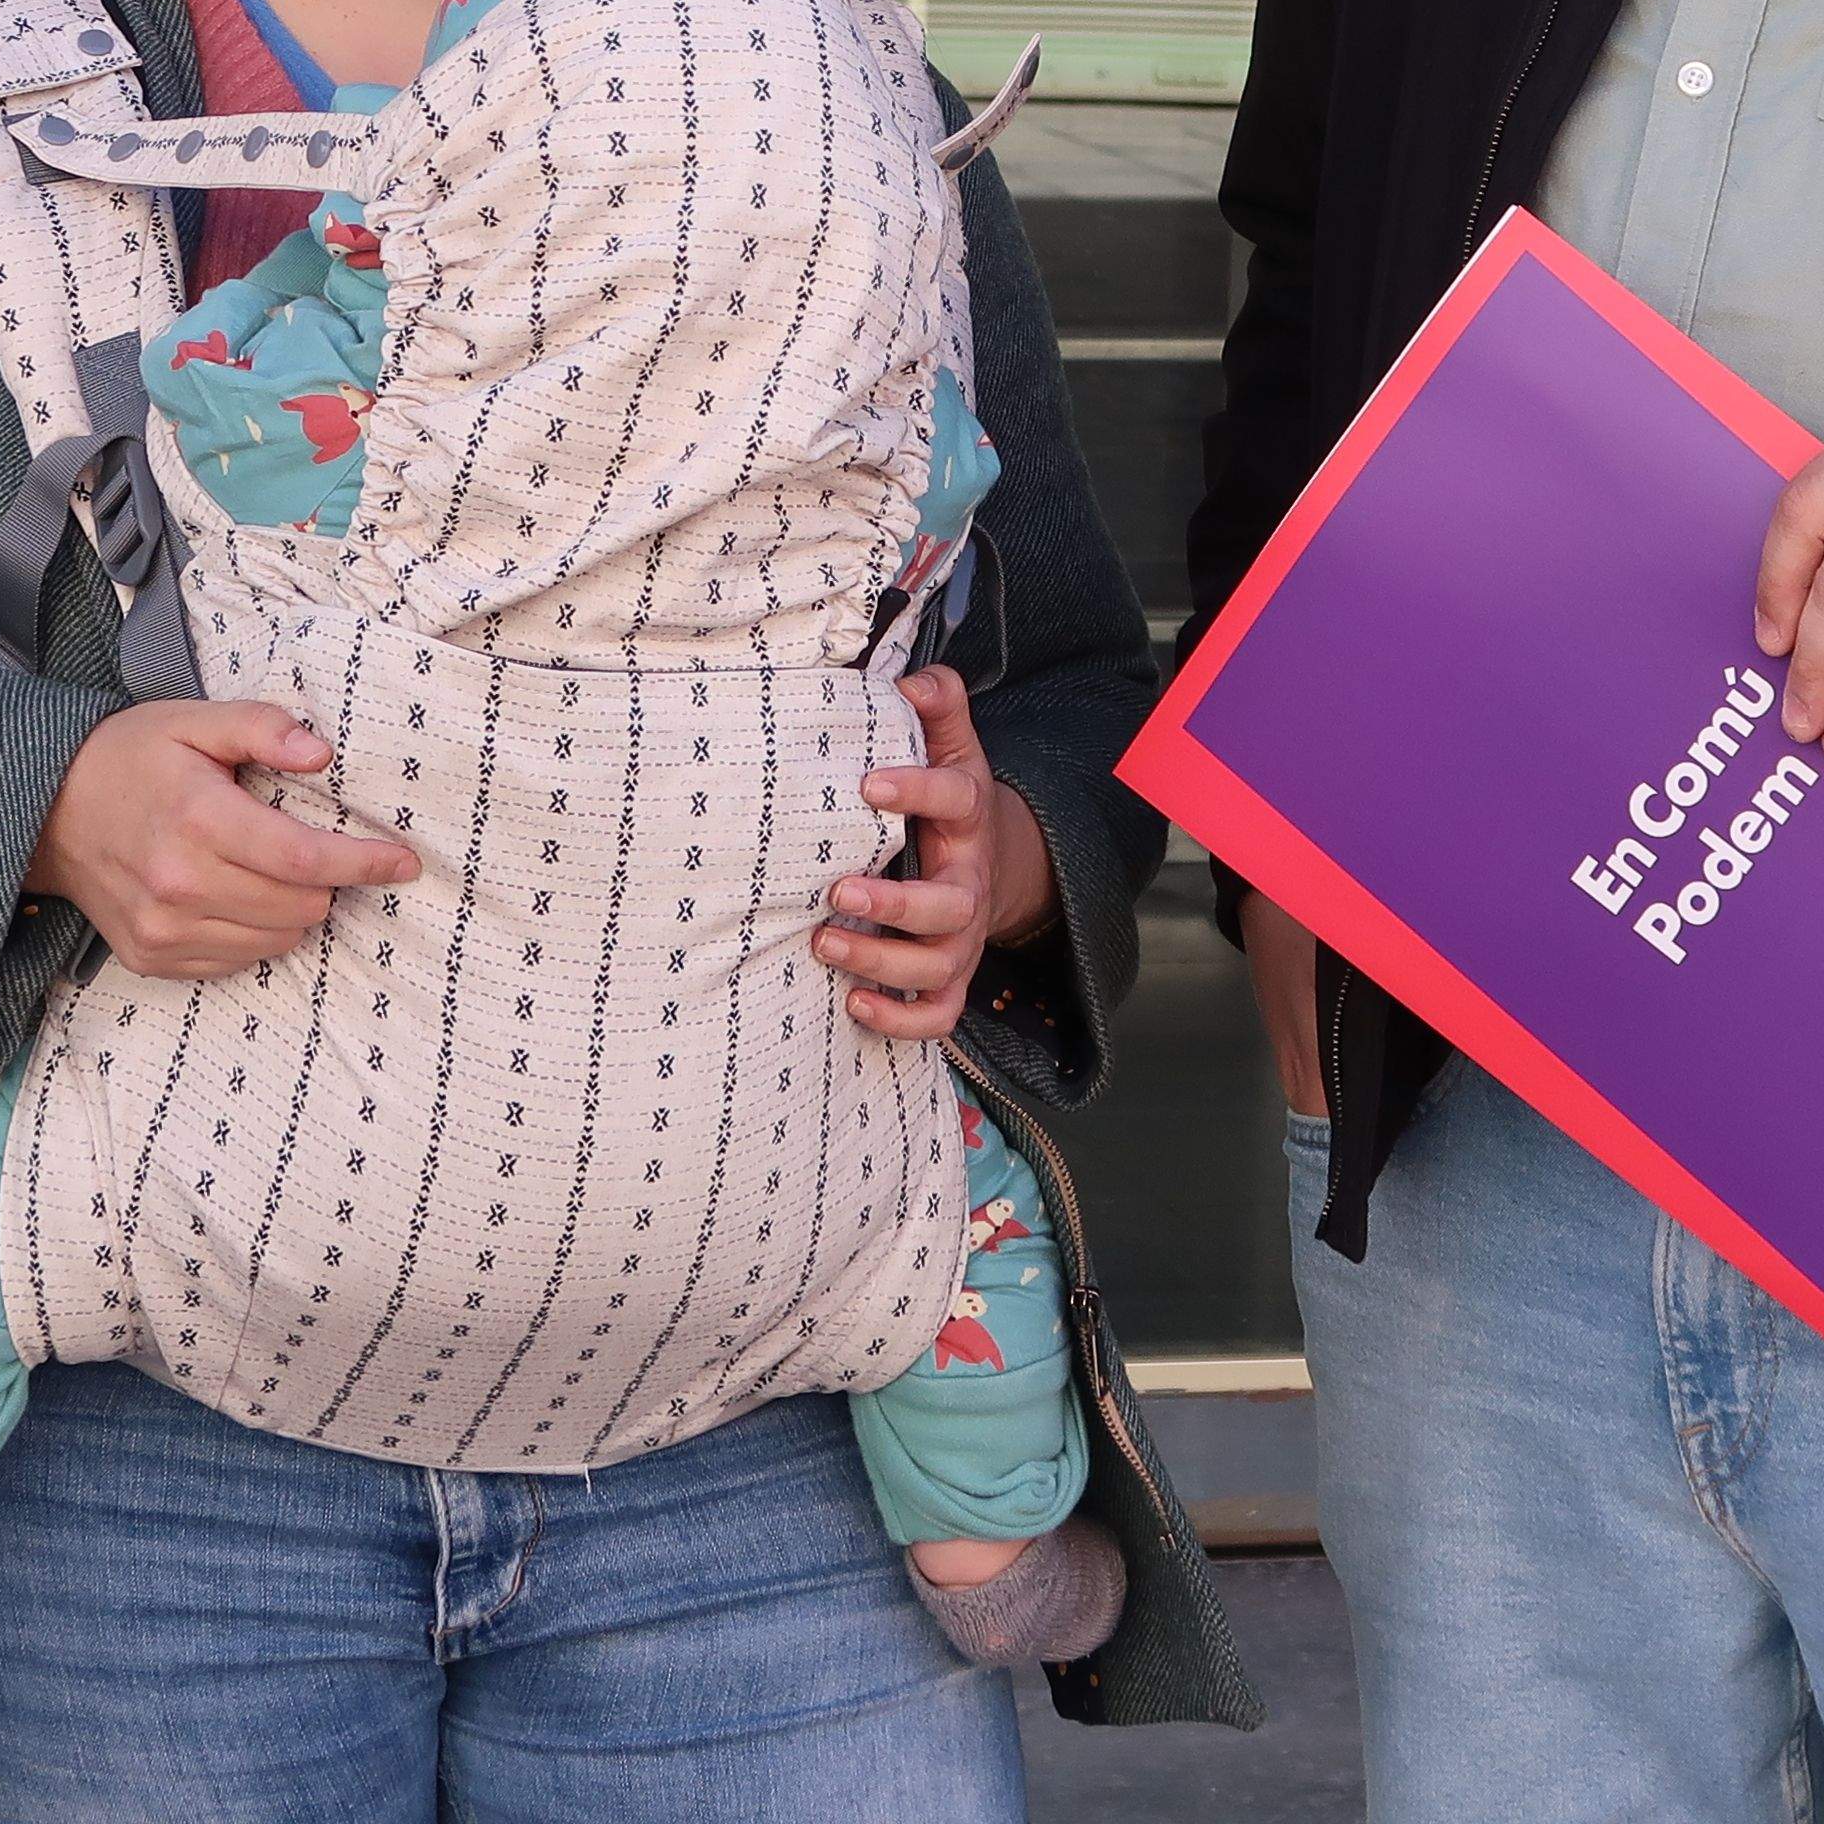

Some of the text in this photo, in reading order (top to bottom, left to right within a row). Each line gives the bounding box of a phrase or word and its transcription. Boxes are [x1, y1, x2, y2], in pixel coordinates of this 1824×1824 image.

[1569, 665, 1776, 917] En Comú
[1632, 754, 1821, 967] Podem
